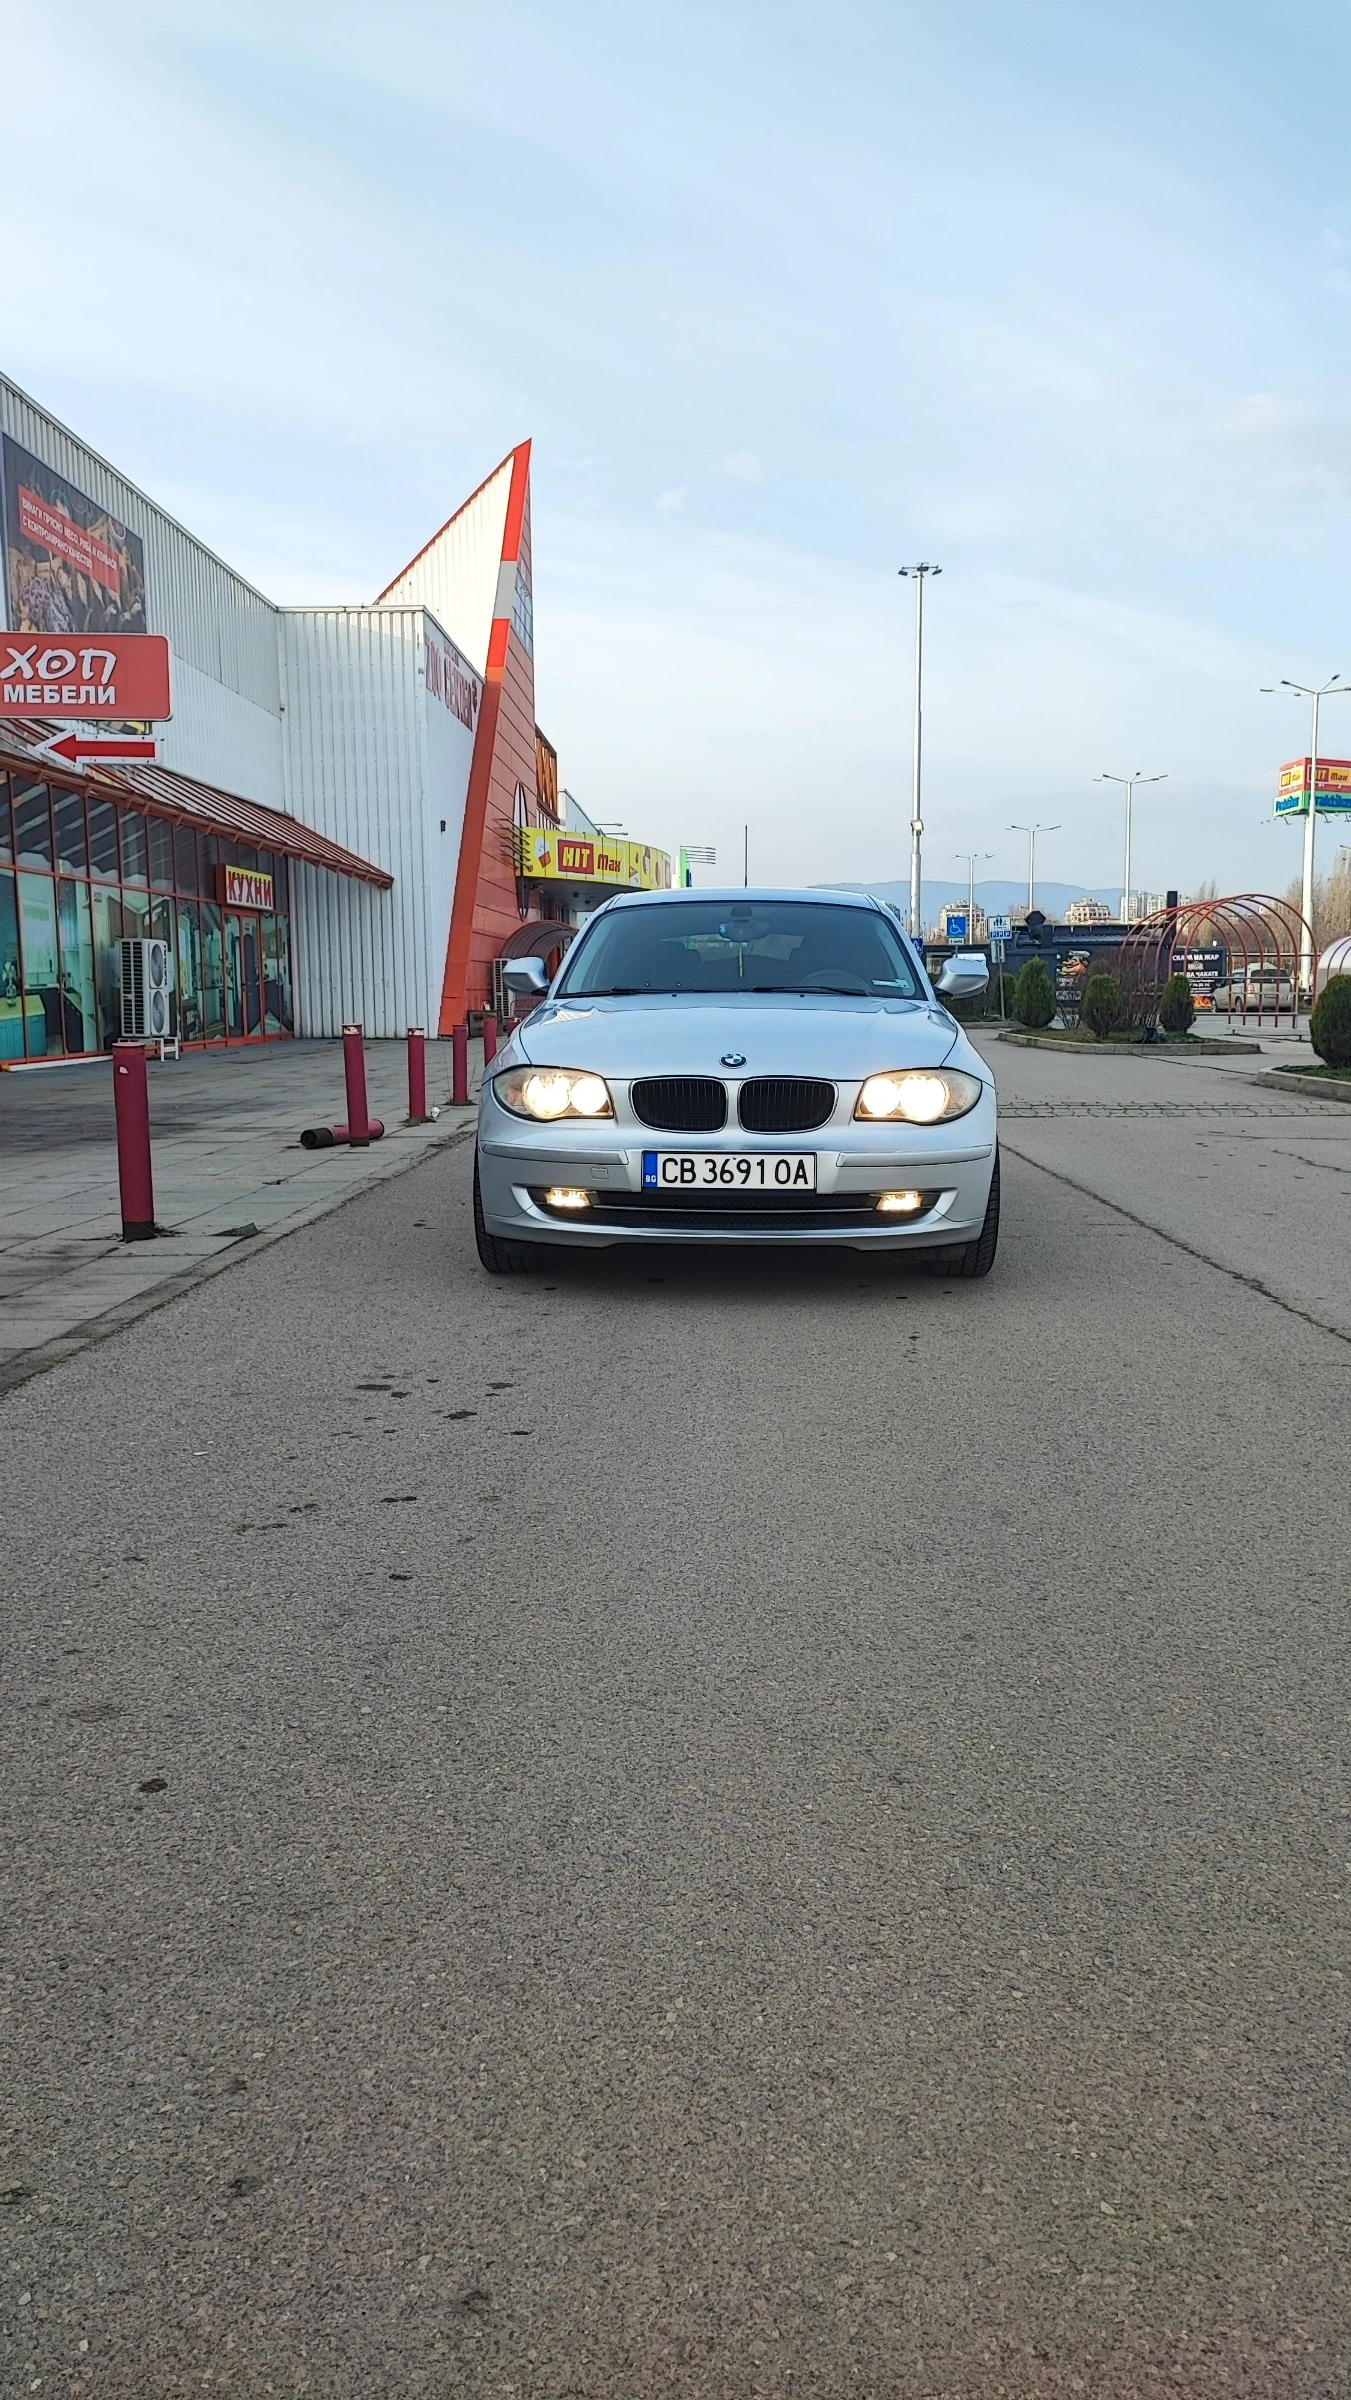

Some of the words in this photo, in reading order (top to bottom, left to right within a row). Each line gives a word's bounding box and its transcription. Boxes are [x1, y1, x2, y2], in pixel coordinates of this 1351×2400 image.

[22, 515, 28, 526] С
[4, 684, 116, 704] МЕБЕЛИ
[562, 846, 591, 869] HIT
[598, 853, 621, 872] Max
[228, 870, 272, 907] КУХНИ
[645, 1174, 657, 1183] BG
[662, 1157, 697, 1184] CB
[702, 1158, 765, 1185] 3691
[774, 1158, 809, 1185] OA
